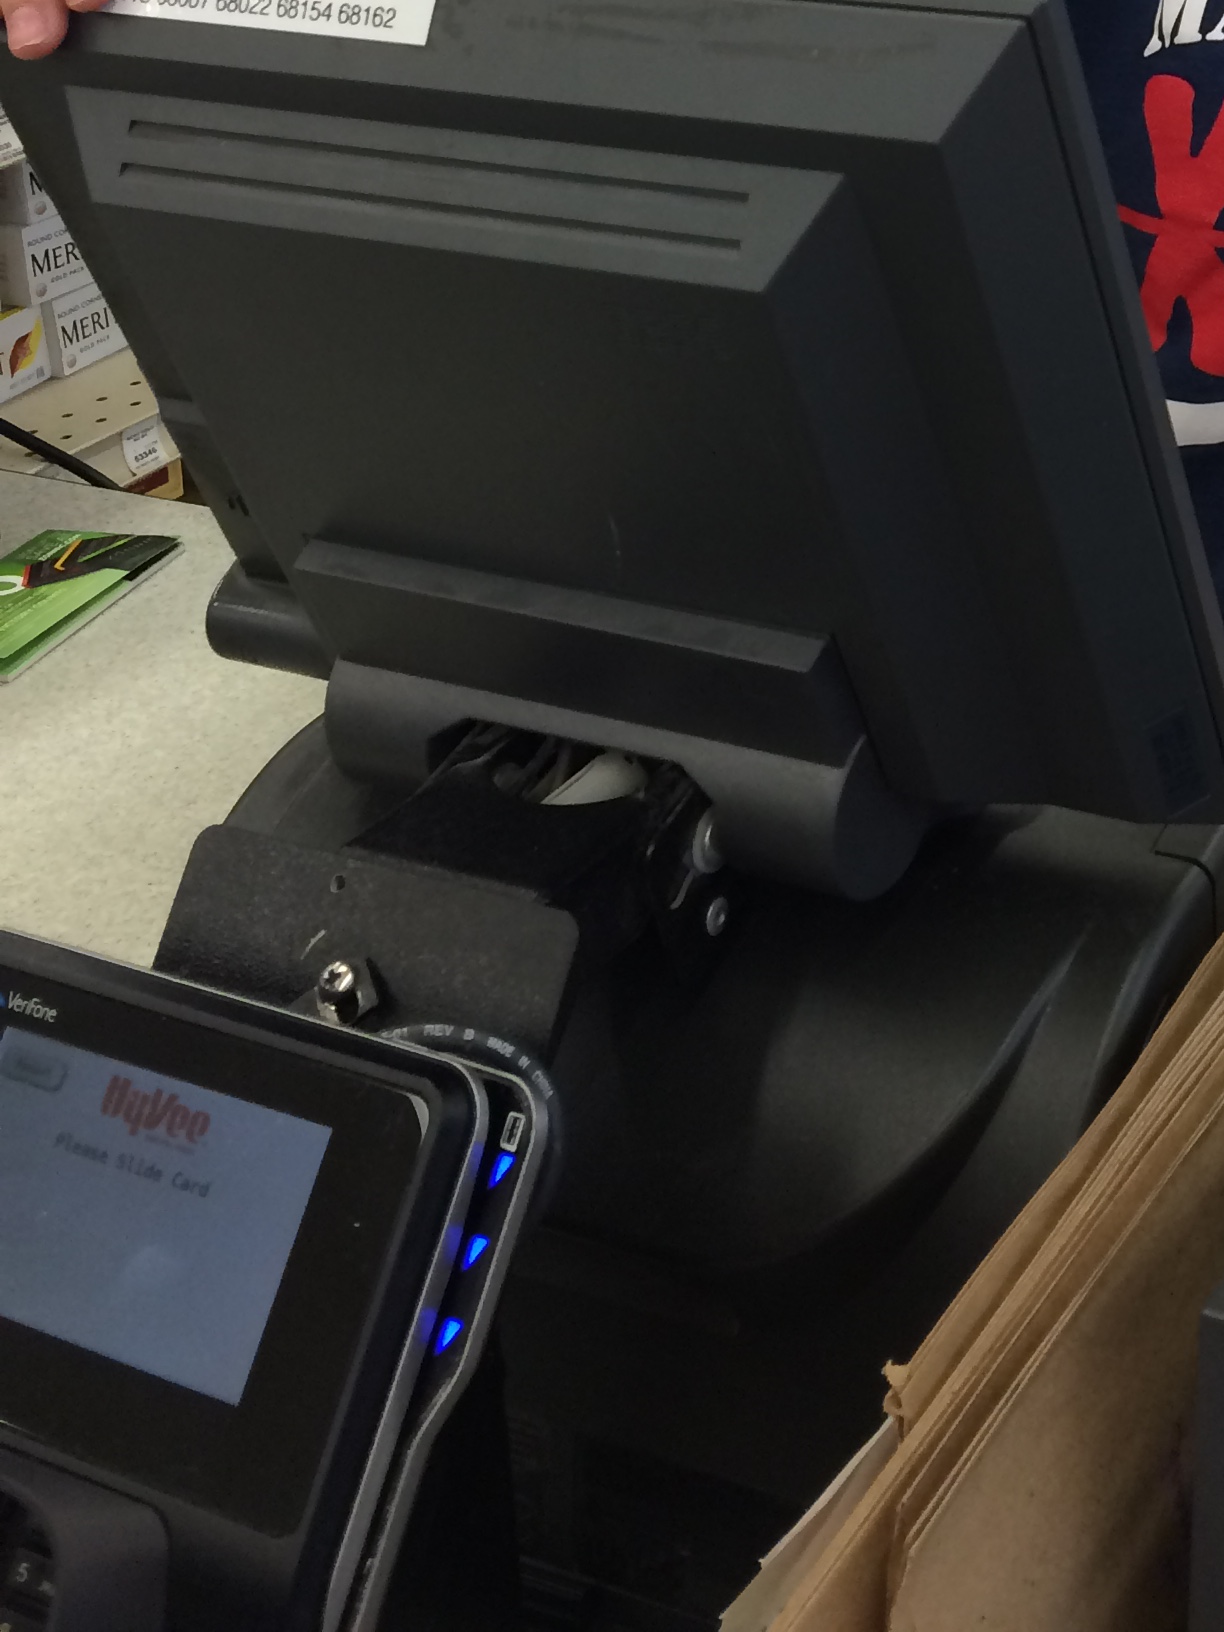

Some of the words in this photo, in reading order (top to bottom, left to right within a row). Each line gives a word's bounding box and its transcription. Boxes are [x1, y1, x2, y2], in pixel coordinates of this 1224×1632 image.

[337, 1, 397, 29] 68162
[61, 307, 110, 349] MERI
[424, 1024, 454, 1036] REV
[487, 1036, 515, 1058] MADE
[54, 1132, 108, 1164] Please
[172, 1172, 212, 1198] Card
